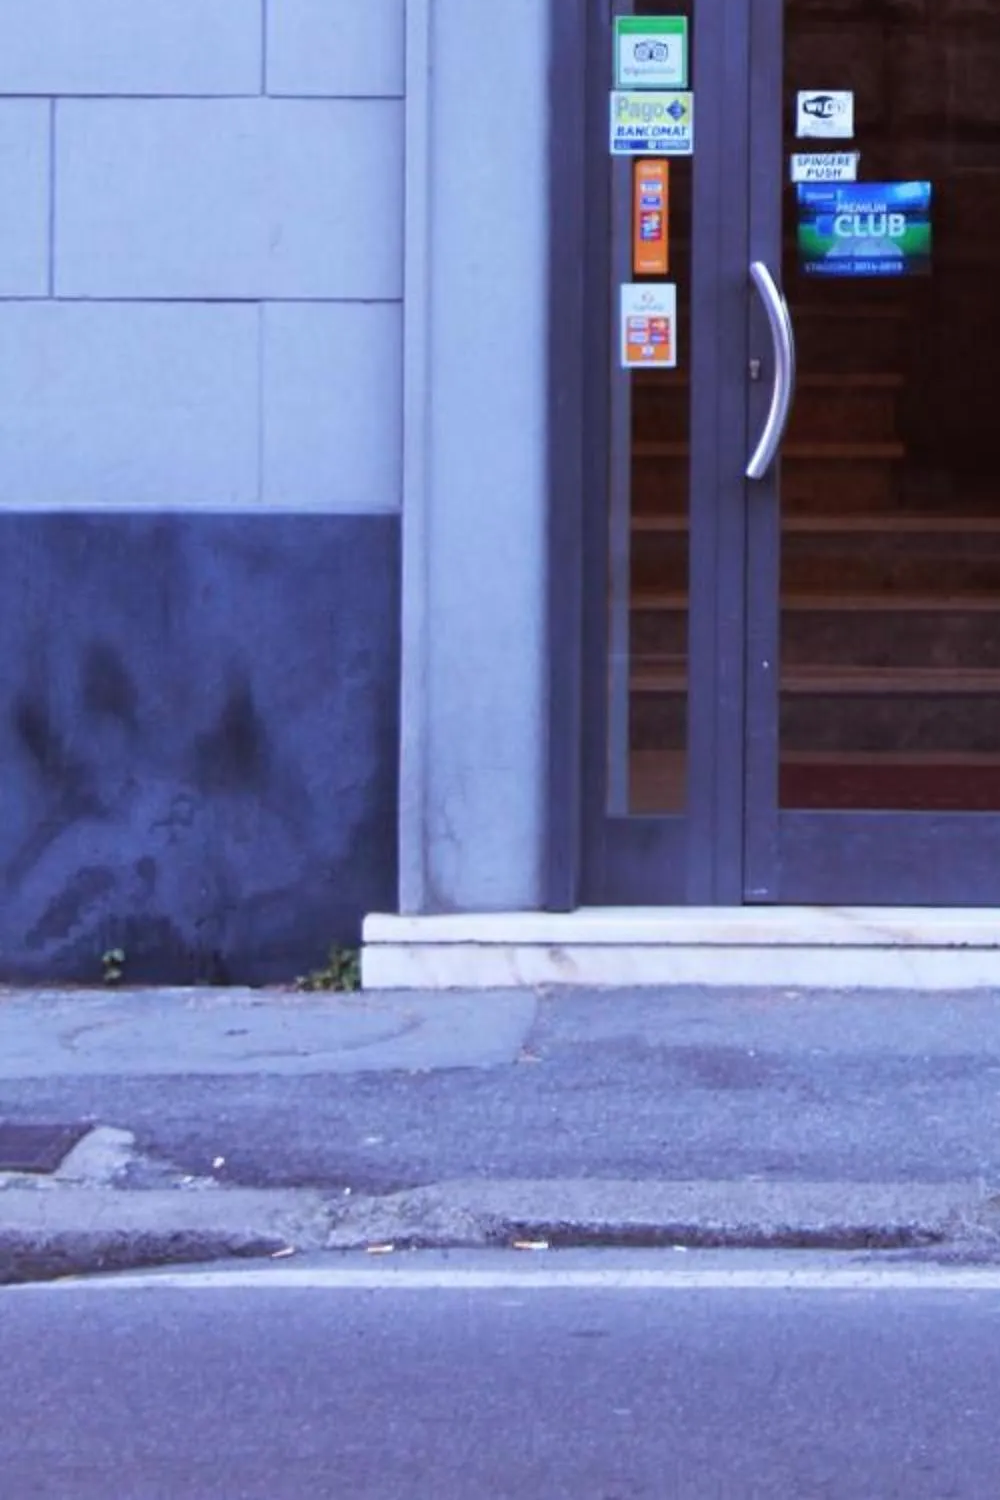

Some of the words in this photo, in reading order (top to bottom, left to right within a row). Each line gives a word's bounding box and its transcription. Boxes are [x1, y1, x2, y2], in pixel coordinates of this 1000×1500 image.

[616, 97, 664, 122] Pago
[797, 155, 850, 167] SPINGERE
[806, 167, 842, 179] PUSH
[836, 201, 887, 213] PREMIUM
[833, 213, 907, 237] CLUB
